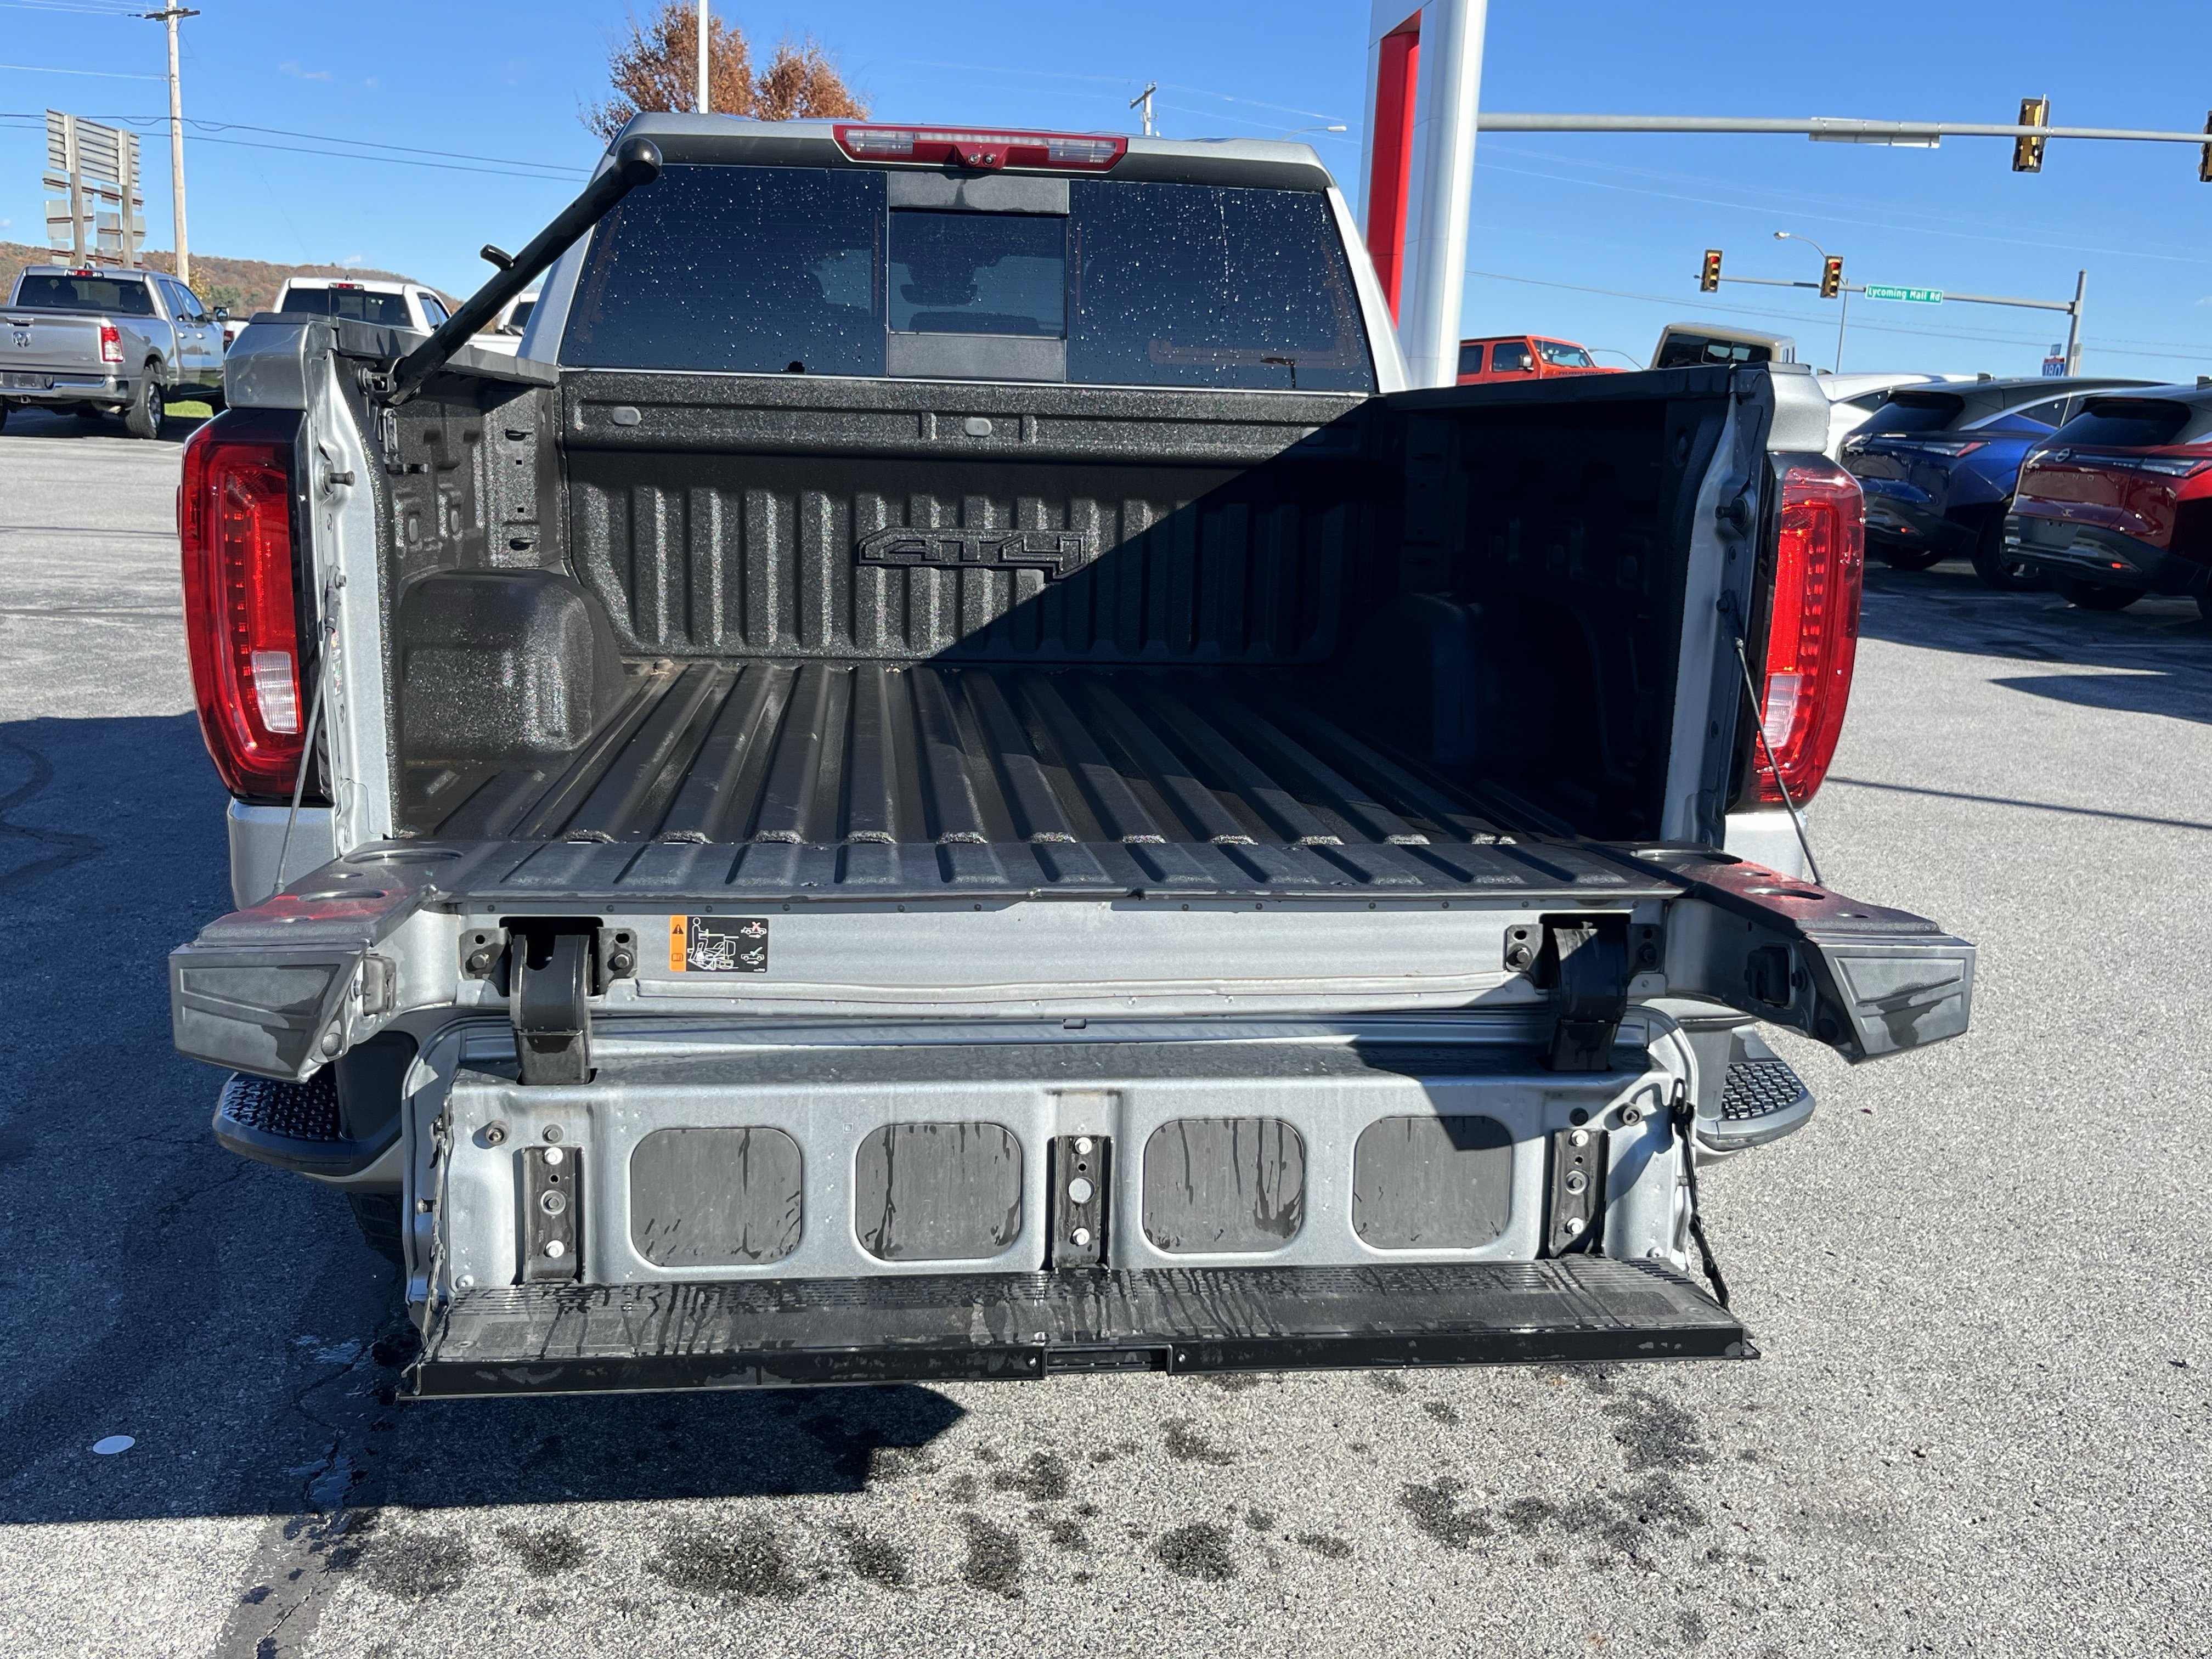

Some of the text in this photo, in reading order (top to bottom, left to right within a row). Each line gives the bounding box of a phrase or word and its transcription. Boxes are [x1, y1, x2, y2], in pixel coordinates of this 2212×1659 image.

[1869, 287, 1940, 301] Lycoming Mall Rd
[859, 527, 1087, 580] AT4
